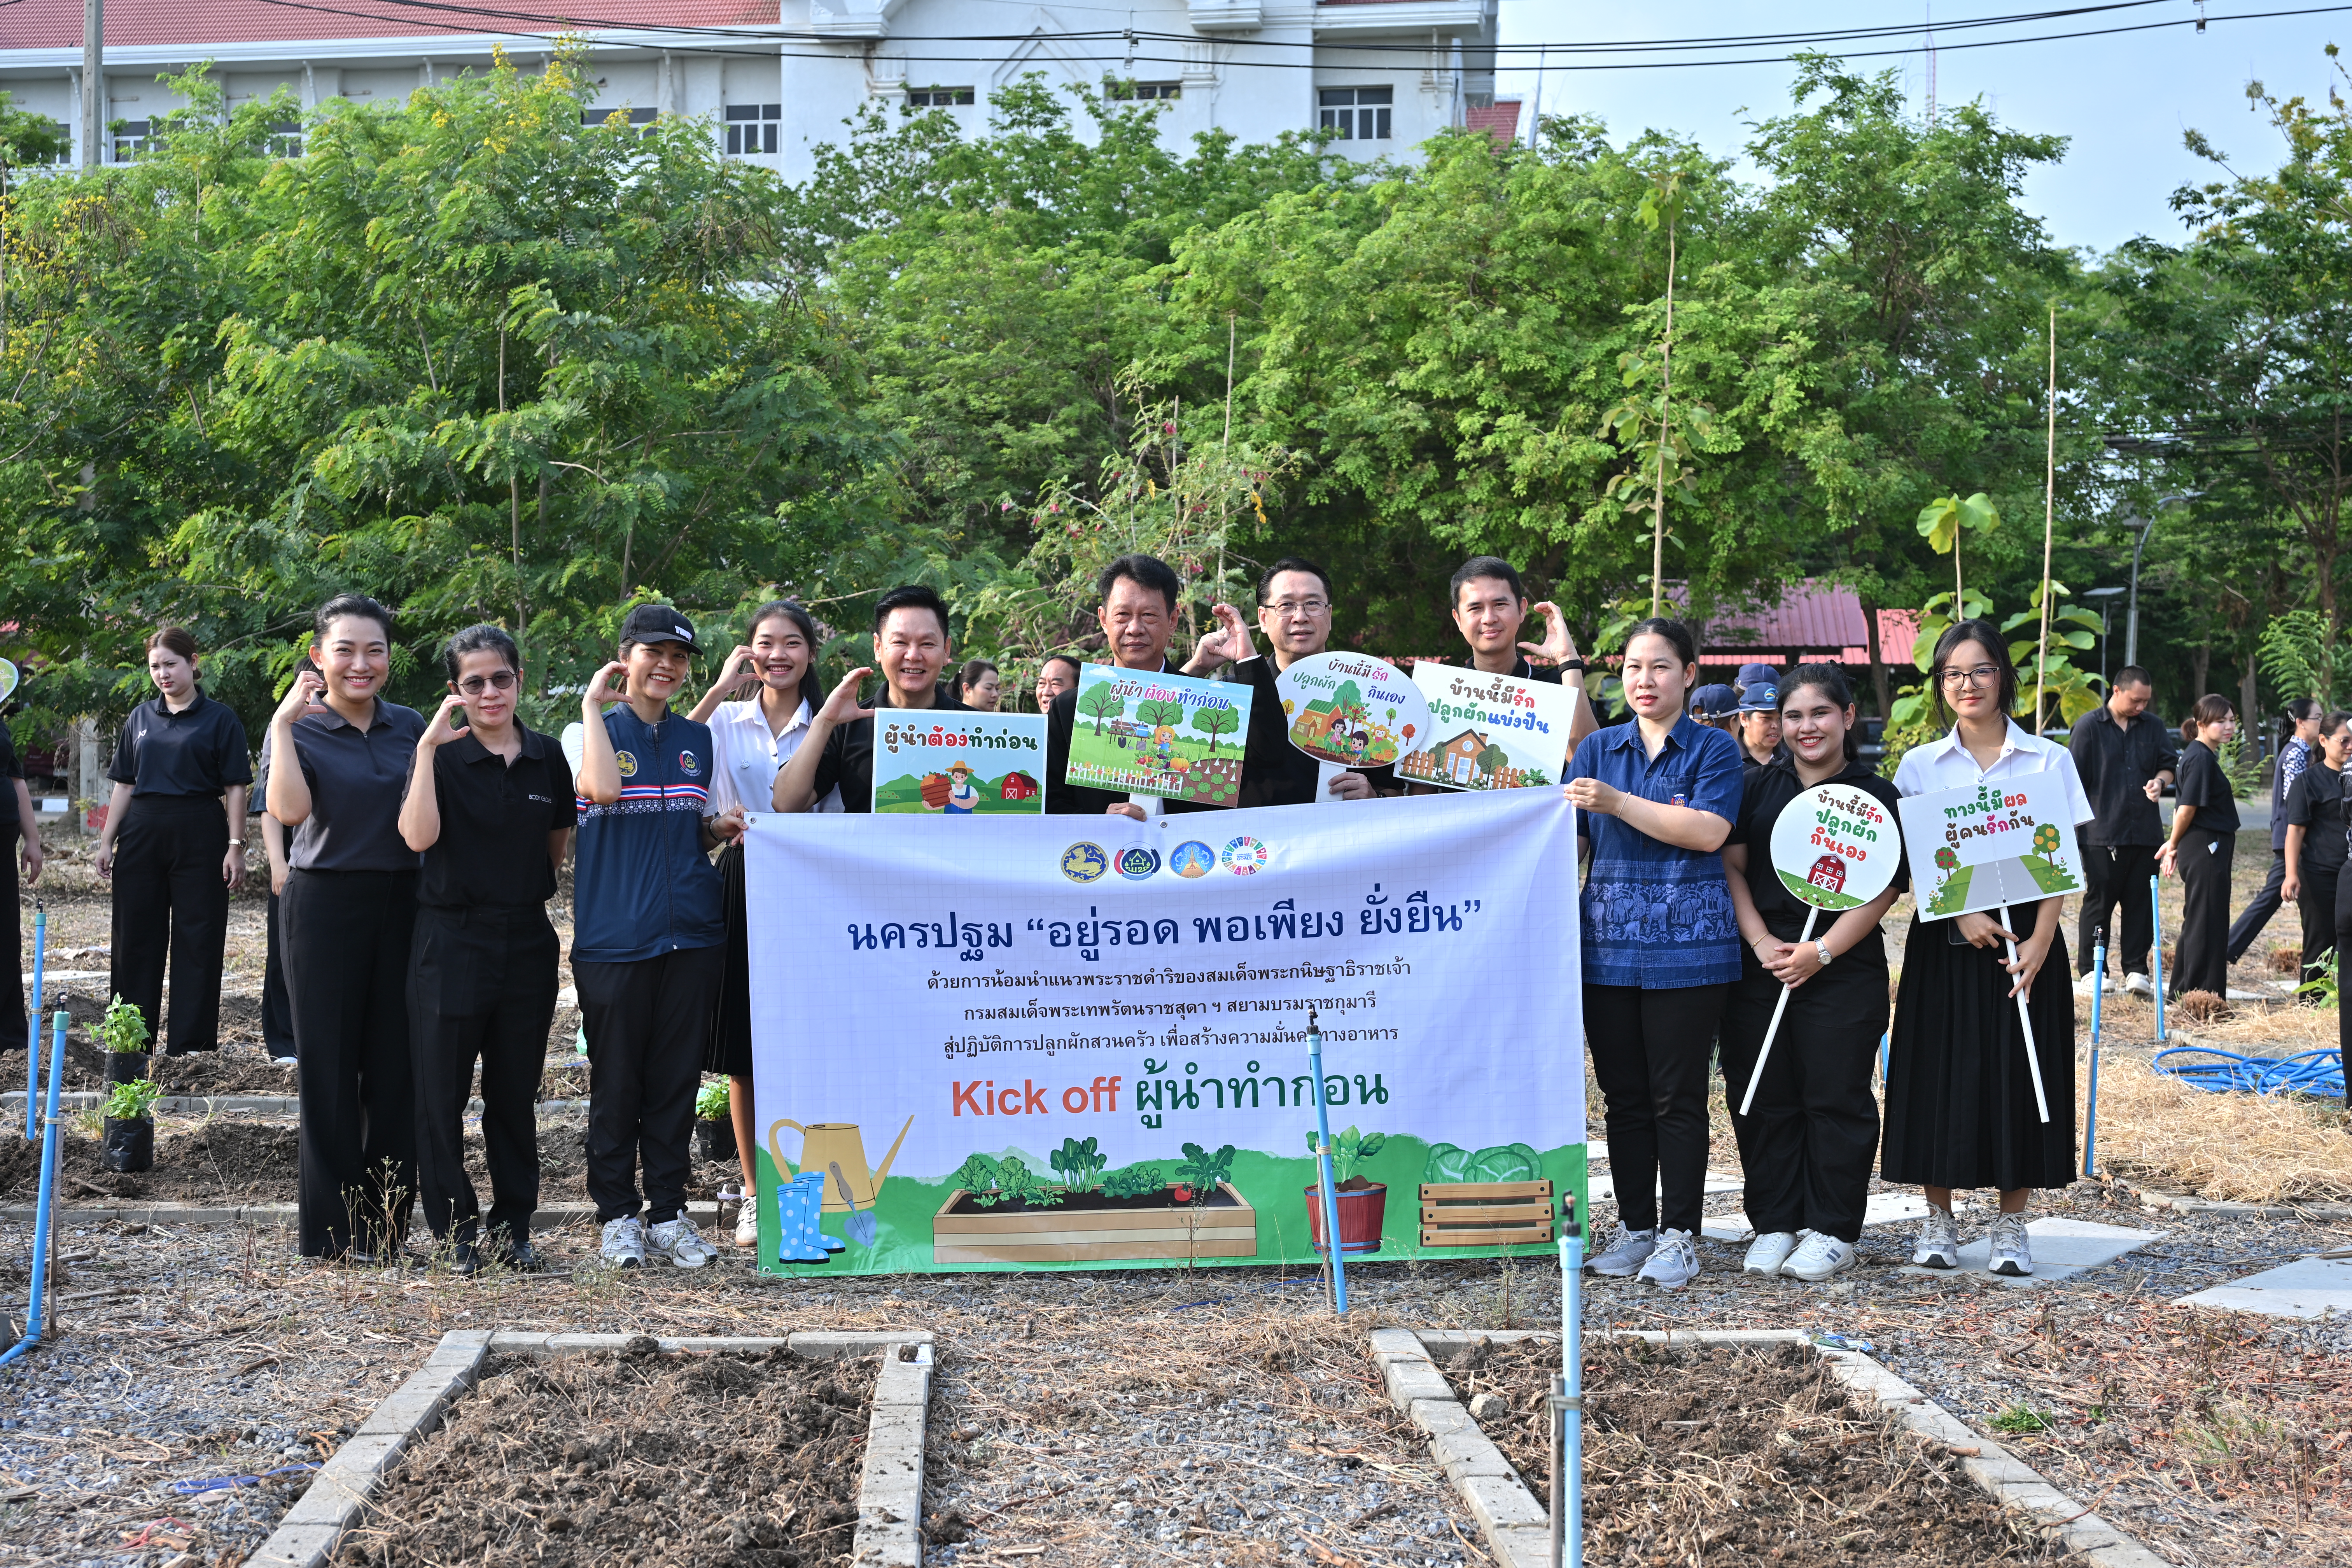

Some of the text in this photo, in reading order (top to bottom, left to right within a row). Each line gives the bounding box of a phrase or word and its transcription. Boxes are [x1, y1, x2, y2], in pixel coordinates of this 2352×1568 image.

[1293, 672, 1336, 690] ปลูกผัก
[1367, 685, 1406, 704] กินเอง
[1450, 677, 1535, 708] บ้านนี้มีรัก
[1428, 698, 1549, 734] ปลูกผักแบ่งปัน
[884, 724, 1038, 753] ผู้นำต้องทำก่อน
[1818, 789, 1883, 824] บ้านนี้มีรัก
[1944, 786, 2027, 819] ทางนี้มีผล
[1816, 808, 1877, 842] ปลูกผัก
[1945, 810, 2035, 849] ผู้คนรักกัน
[1811, 826, 1866, 861] กินเอง
[847, 883, 1481, 962] นครปฐม “อยู่รอด พอเพียง ยั่งยืน”
[927, 956, 1411, 989] ด้วยการน้อมนำแนวพระราชดำริของสมเด็จพระกนิษฐาธิราชเจ้า
[964, 998, 1206, 1020] กรมสมเด็จพระเทพรัตนราชสุดา
[1212, 1002, 1221, 1013] ฯ
[943, 1020, 1398, 1059] สู่ปฏิบัติการปลูกผักสวนครัว เพื่อสร้างความมั่นคทางอาหาร
[952, 1079, 1049, 1117] Kick
[1062, 1076, 1122, 1113] off
